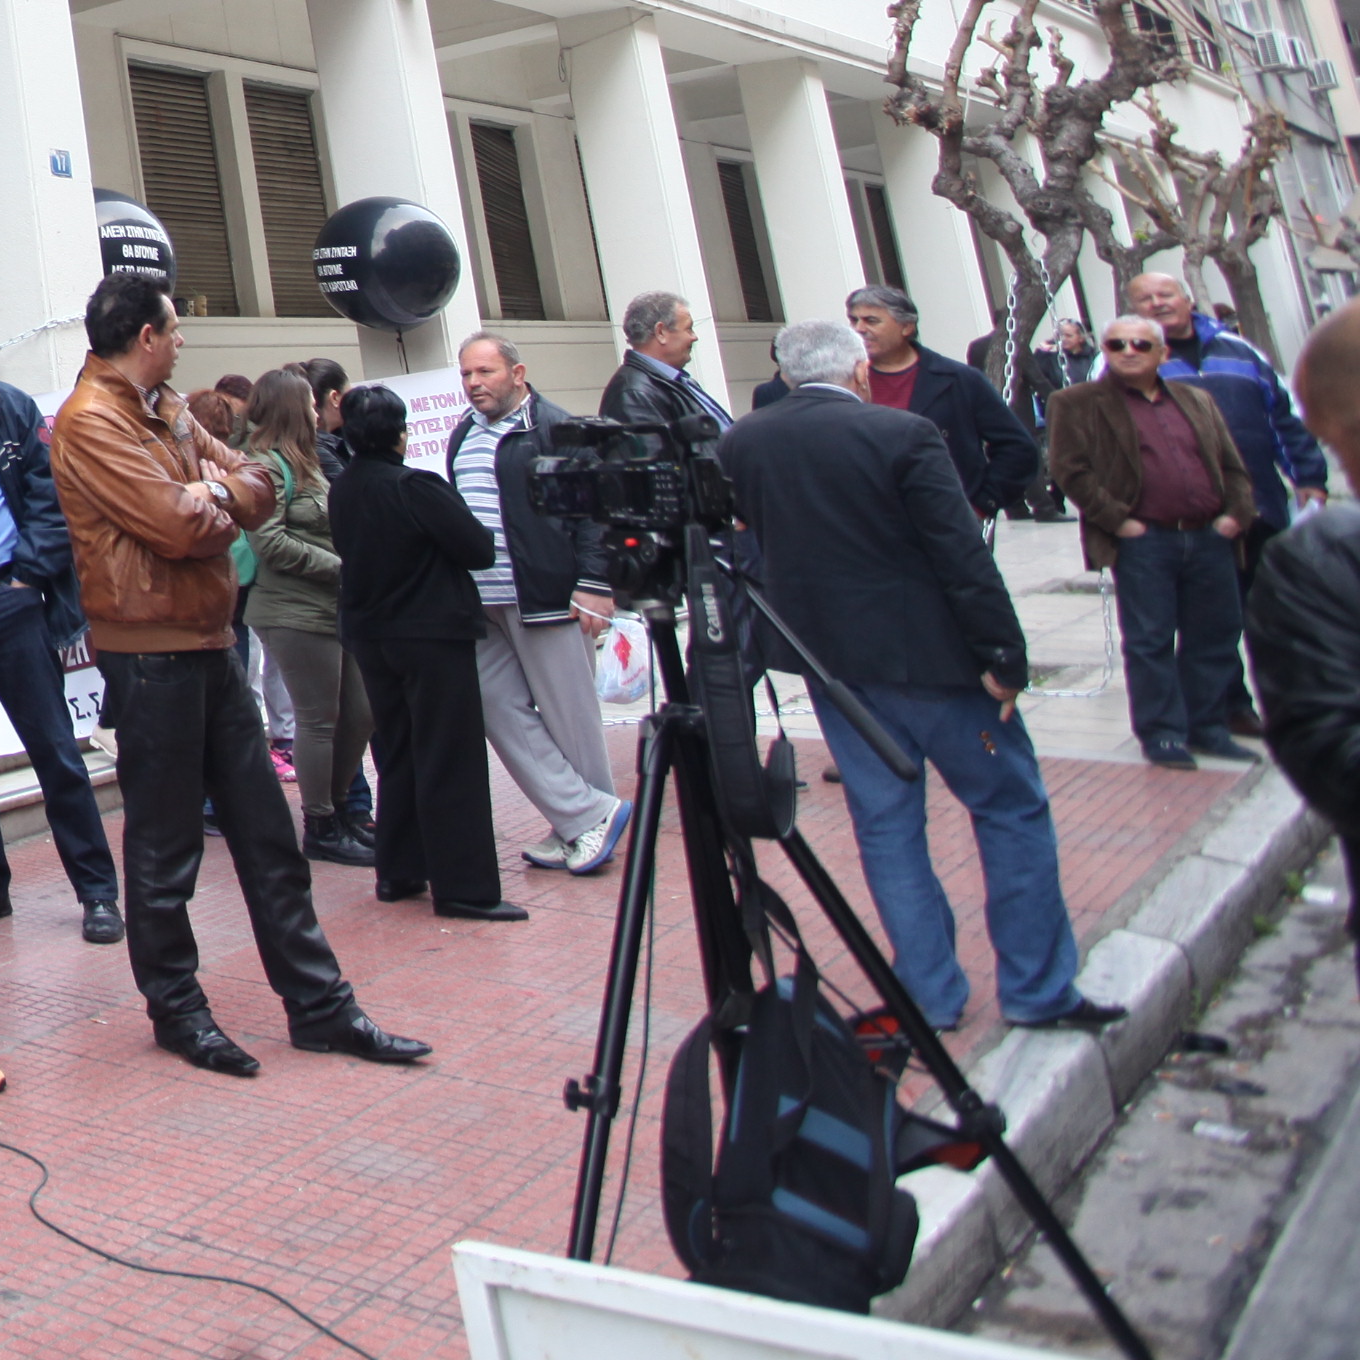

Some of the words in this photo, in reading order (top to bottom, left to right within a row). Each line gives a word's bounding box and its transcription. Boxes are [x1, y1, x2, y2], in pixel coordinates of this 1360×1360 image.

[101, 225, 126, 239] ΑΛΕΞΗ
[122, 244, 134, 258] ΘΑ
[410, 396, 430, 413] ΜΕ
[430, 392, 457, 409] ΤΟΝ
[405, 417, 443, 437] ΕΥΤΕΣ
[422, 440, 439, 456] ΤΟ
[701, 583, 723, 643] Canon
